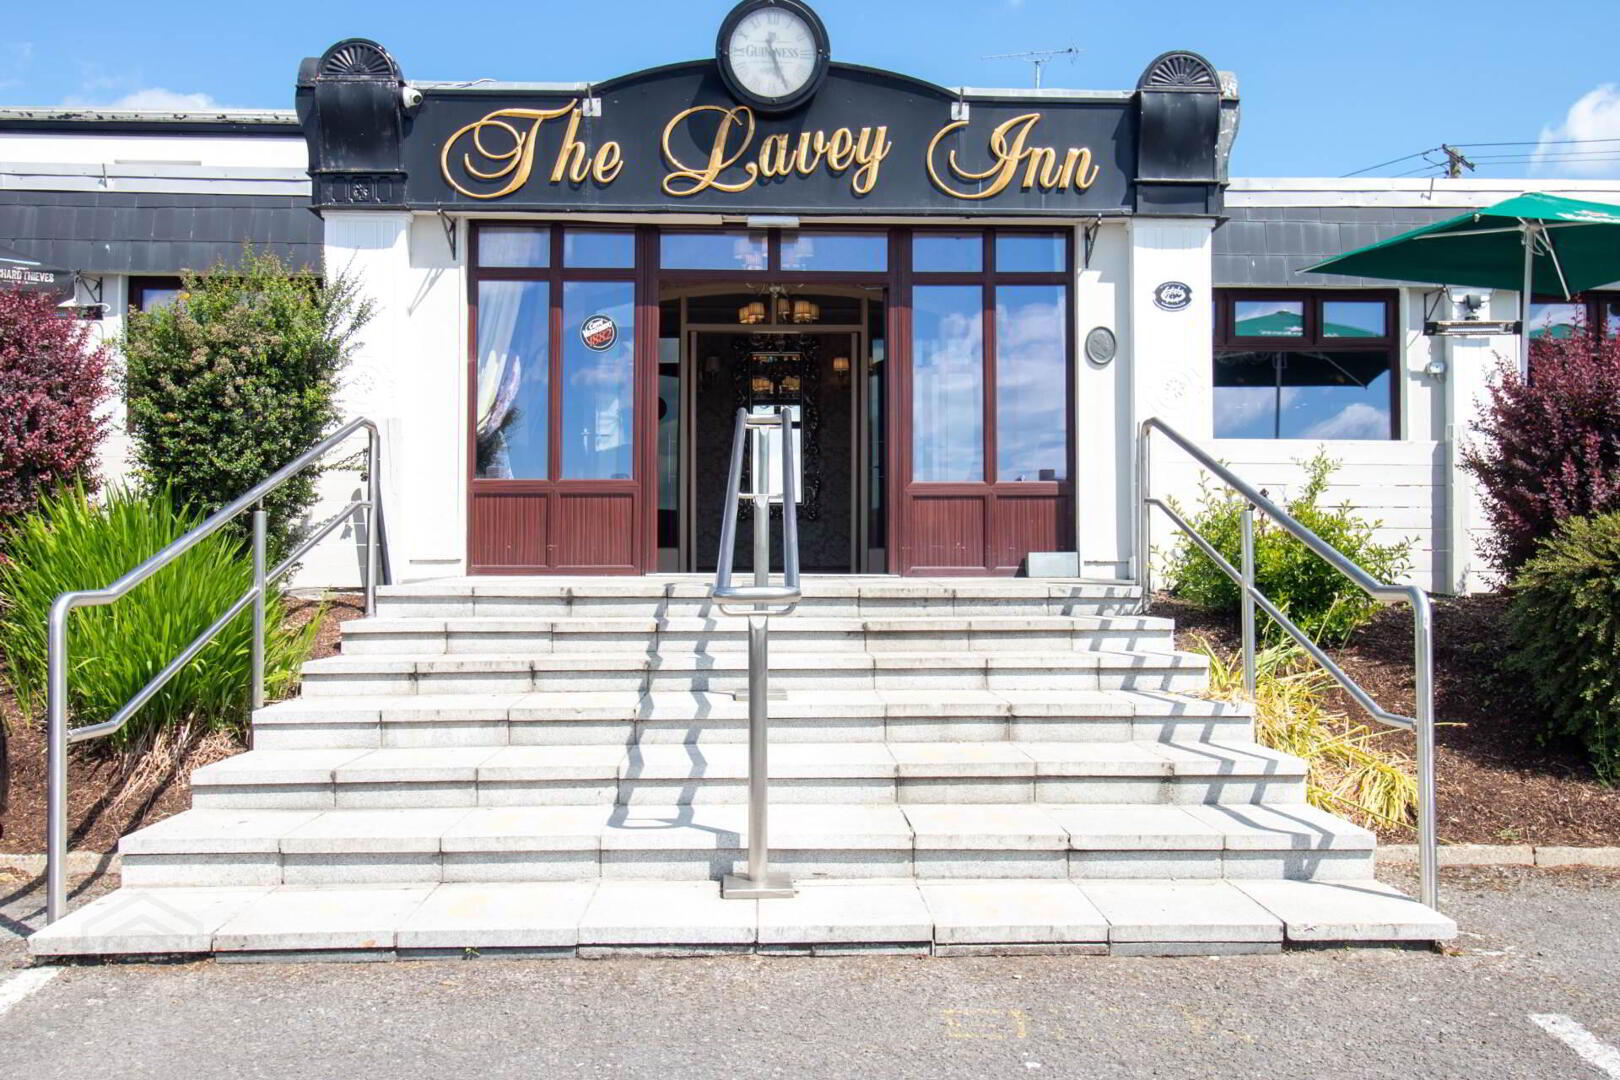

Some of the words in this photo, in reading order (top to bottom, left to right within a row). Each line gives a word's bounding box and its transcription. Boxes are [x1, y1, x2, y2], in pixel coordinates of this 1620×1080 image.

[440, 98, 624, 199] The
[661, 105, 892, 196] Lavey
[926, 113, 1100, 199] Inn
